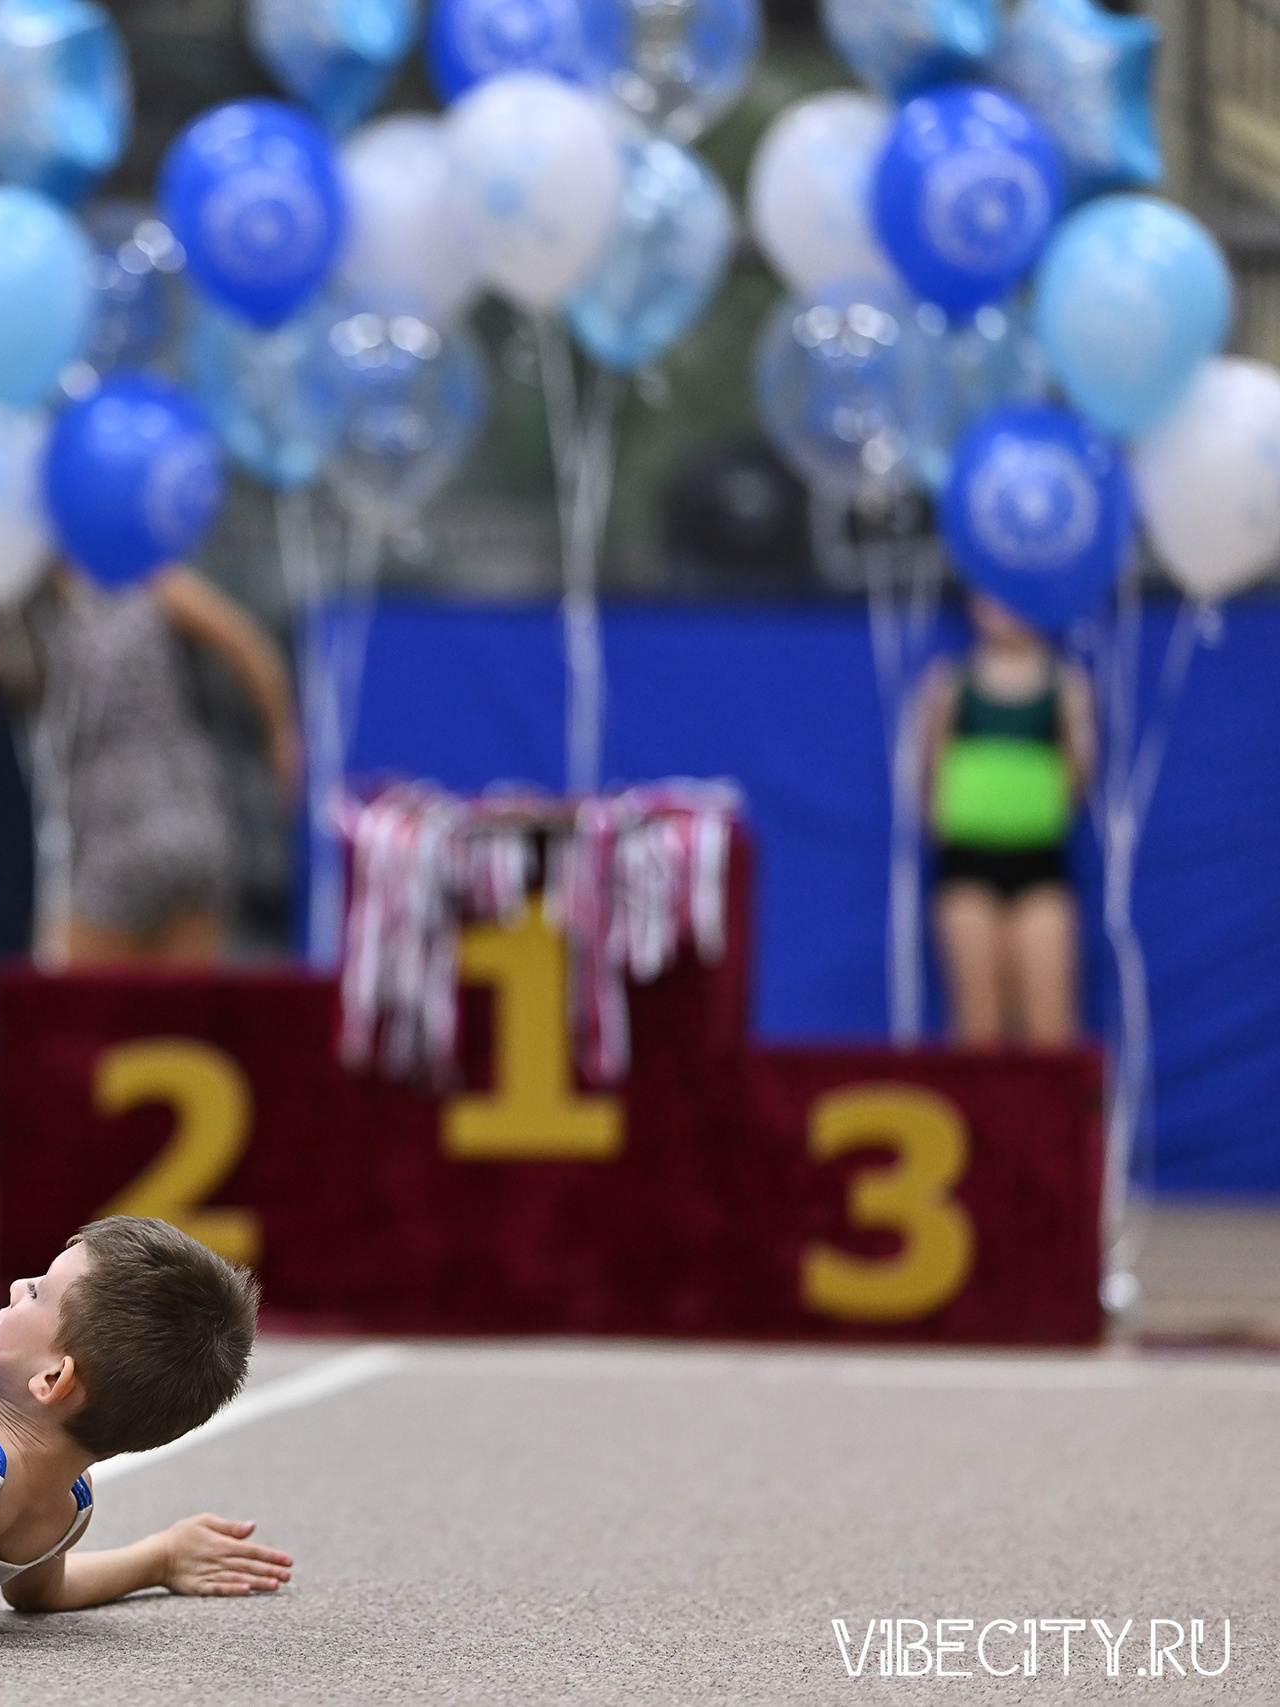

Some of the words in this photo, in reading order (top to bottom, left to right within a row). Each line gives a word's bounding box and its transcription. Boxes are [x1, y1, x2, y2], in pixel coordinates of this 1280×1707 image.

[444, 896, 623, 1158] 1
[95, 1041, 259, 1262] 2
[802, 1086, 973, 1320] 3
